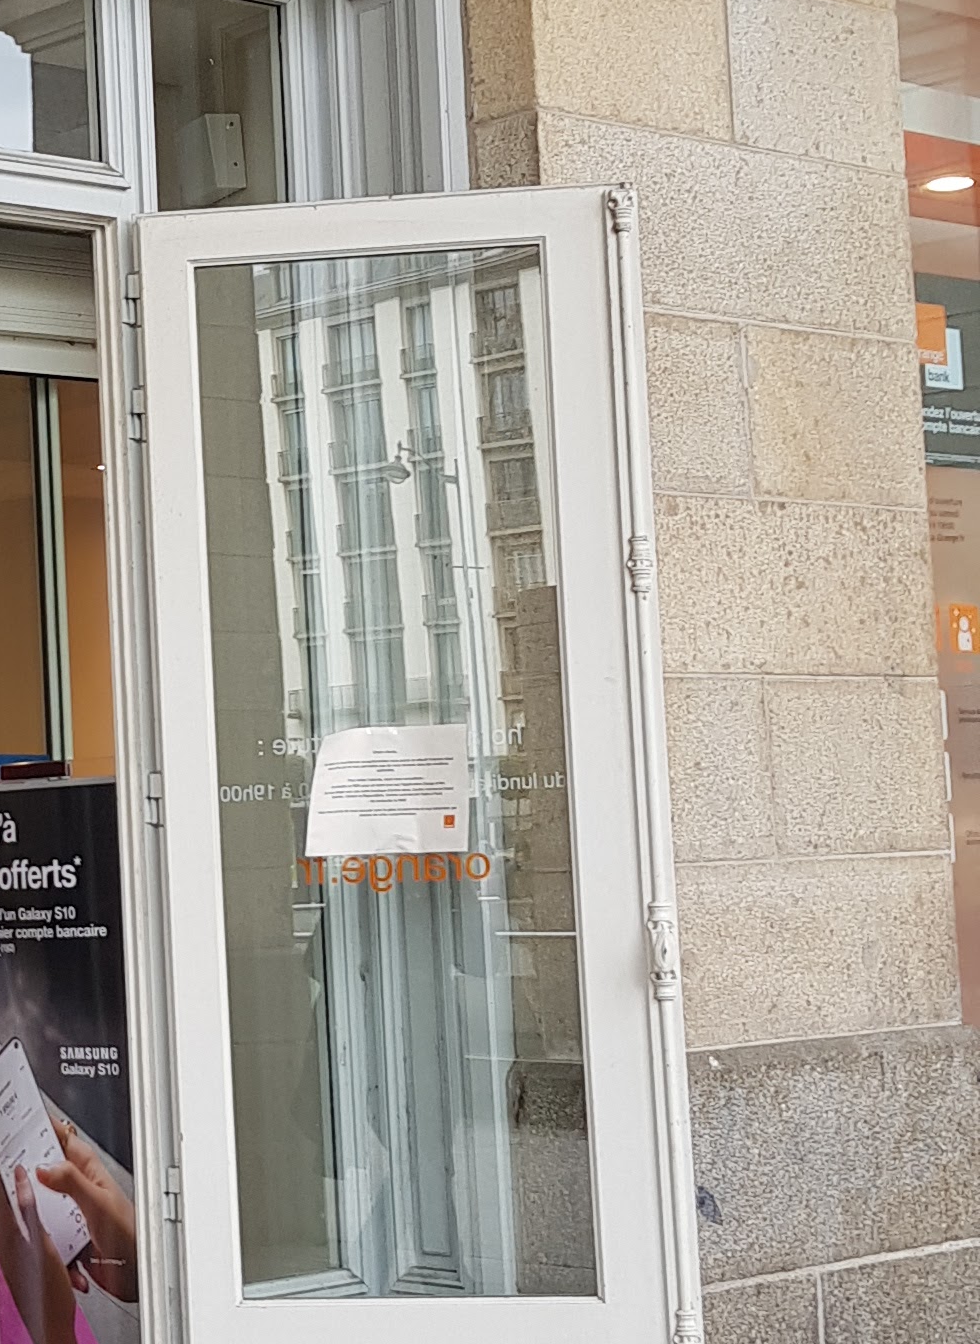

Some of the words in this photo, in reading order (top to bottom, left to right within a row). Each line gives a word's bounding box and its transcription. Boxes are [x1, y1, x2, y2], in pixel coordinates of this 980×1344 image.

[18, 907, 53, 923] Galaxy
[54, 906, 76, 920] S10
[15, 925, 54, 941] compte
[55, 924, 108, 938] bancaire
[60, 1046, 119, 1060] SAMSUNG
[60, 1062, 96, 1078] Galaxy
[97, 1062, 120, 1076] S10
